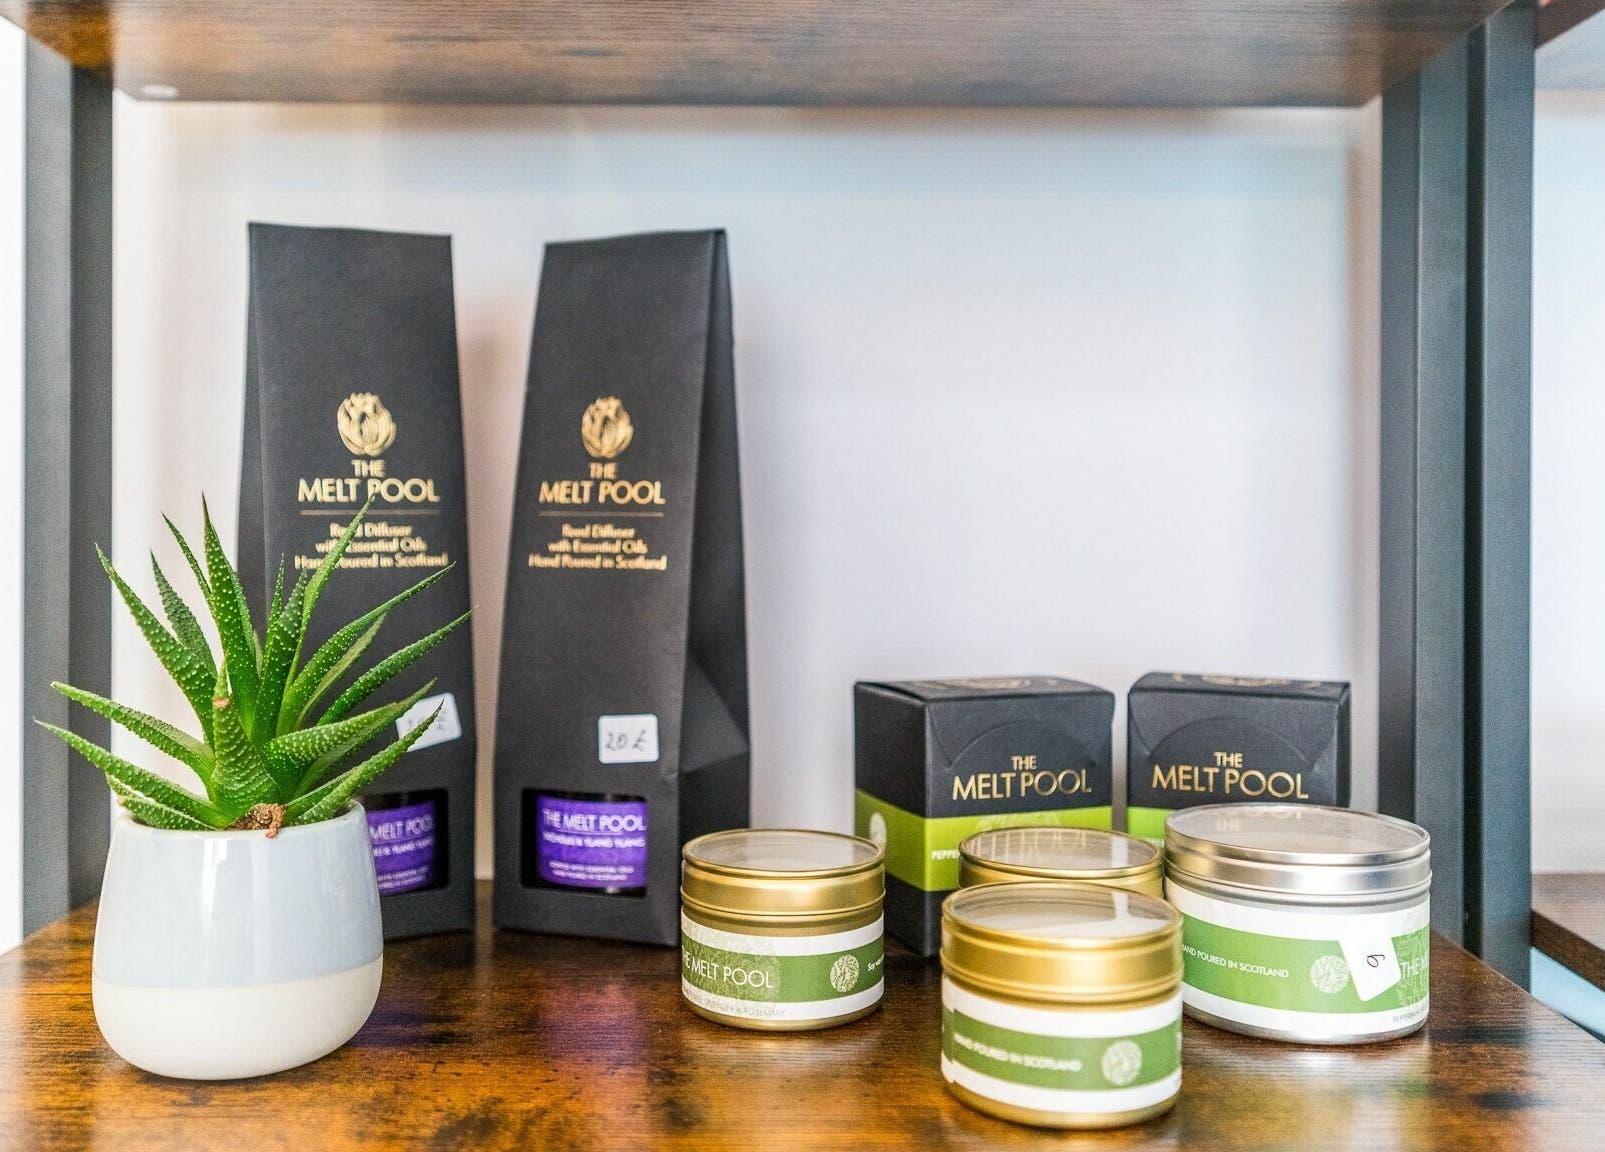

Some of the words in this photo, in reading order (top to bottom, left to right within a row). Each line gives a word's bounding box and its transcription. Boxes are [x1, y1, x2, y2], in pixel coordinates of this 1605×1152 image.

[352, 459, 386, 477] THE
[590, 462, 618, 479] THE
[298, 477, 361, 502] MELT
[367, 477, 440, 503] POOL
[539, 480, 595, 503] MELT
[598, 480, 666, 504] POOL
[329, 522, 363, 537] Red
[605, 731, 629, 751] 20
[1011, 755, 1037, 771] THE
[1213, 751, 1244, 768] THE
[952, 771, 1017, 801] MELT
[1020, 768, 1093, 798] POOL
[1151, 764, 1220, 793] MELT
[1223, 766, 1310, 800] POOL
[405, 814, 433, 837] POO
[542, 808, 562, 829] THE
[562, 812, 598, 831] MELT
[598, 813, 647, 833] POOL
[691, 954, 720, 981] MELT
[723, 965, 774, 989] POOL
[1197, 950, 1227, 967] POURED
[1227, 959, 1238, 970] IN
[1239, 962, 1289, 978] SCOTLAND
[1400, 957, 1420, 979] THE
